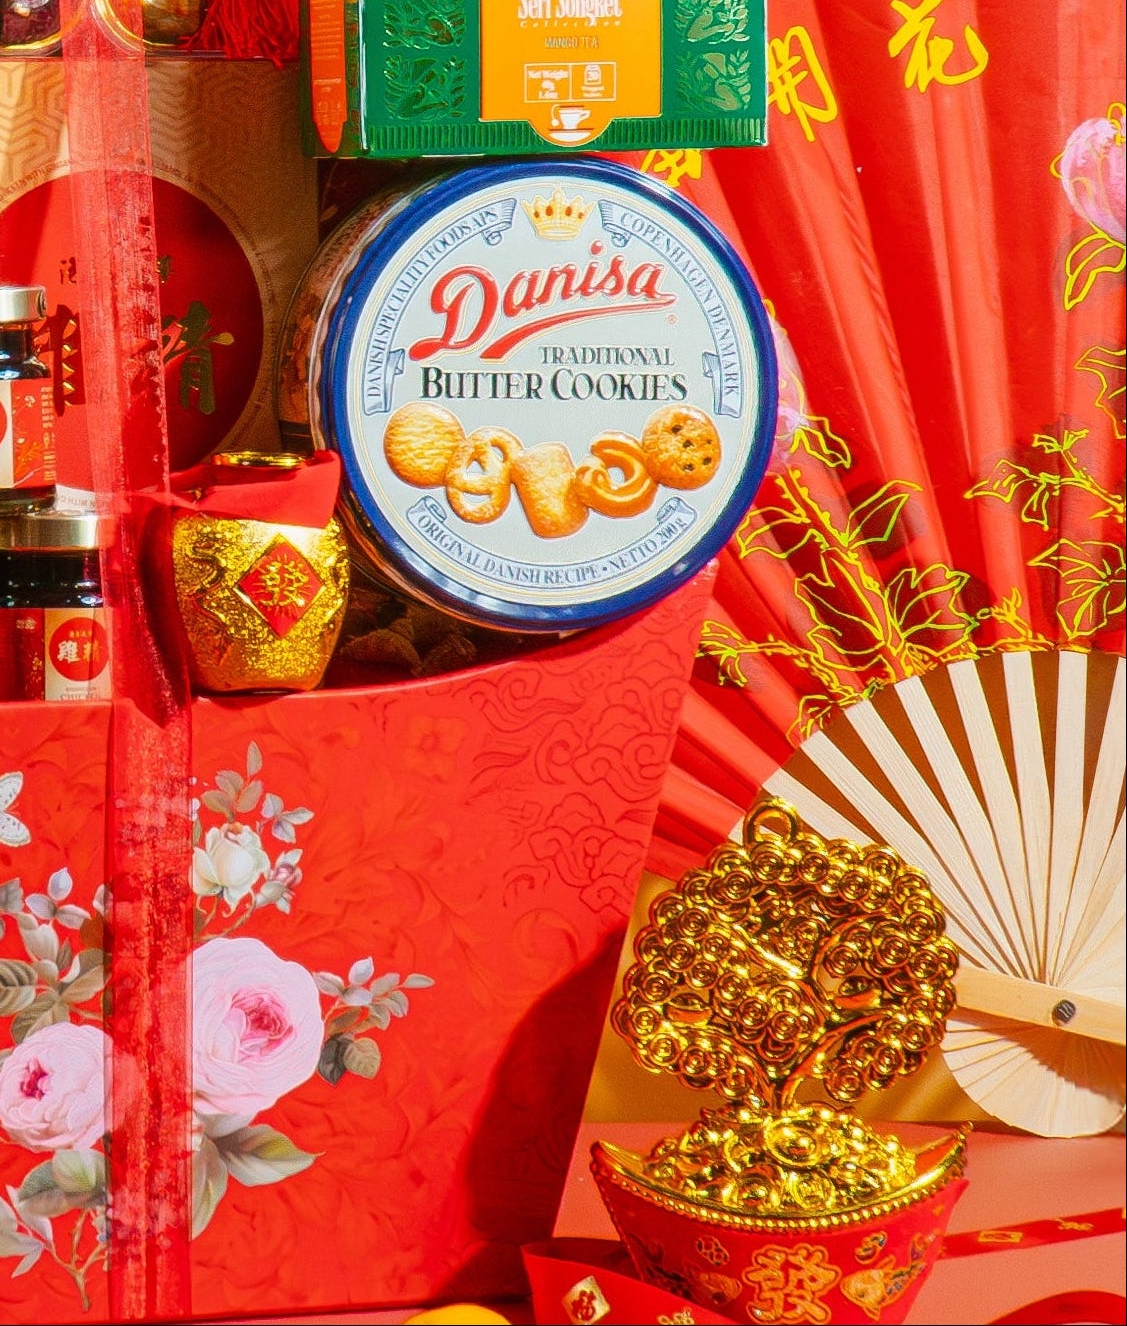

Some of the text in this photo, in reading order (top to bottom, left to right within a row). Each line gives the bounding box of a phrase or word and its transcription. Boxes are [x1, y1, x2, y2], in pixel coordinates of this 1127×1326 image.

[421, 219, 472, 260] FOODS
[372, 254, 434, 340] SPECIALITY
[408, 241, 677, 361] Danisa
[617, 210, 740, 396] COPENHAGEN DENMARK
[367, 338, 387, 397] DANISH
[420, 367, 687, 402] BUTTER COOKIES
[539, 347, 674, 366] TRADITIONAL
[412, 513, 486, 568] ORIGINAL
[480, 556, 540, 584] DANISH
[543, 562, 601, 585] RECIPE
[606, 536, 661, 574] NETTO
